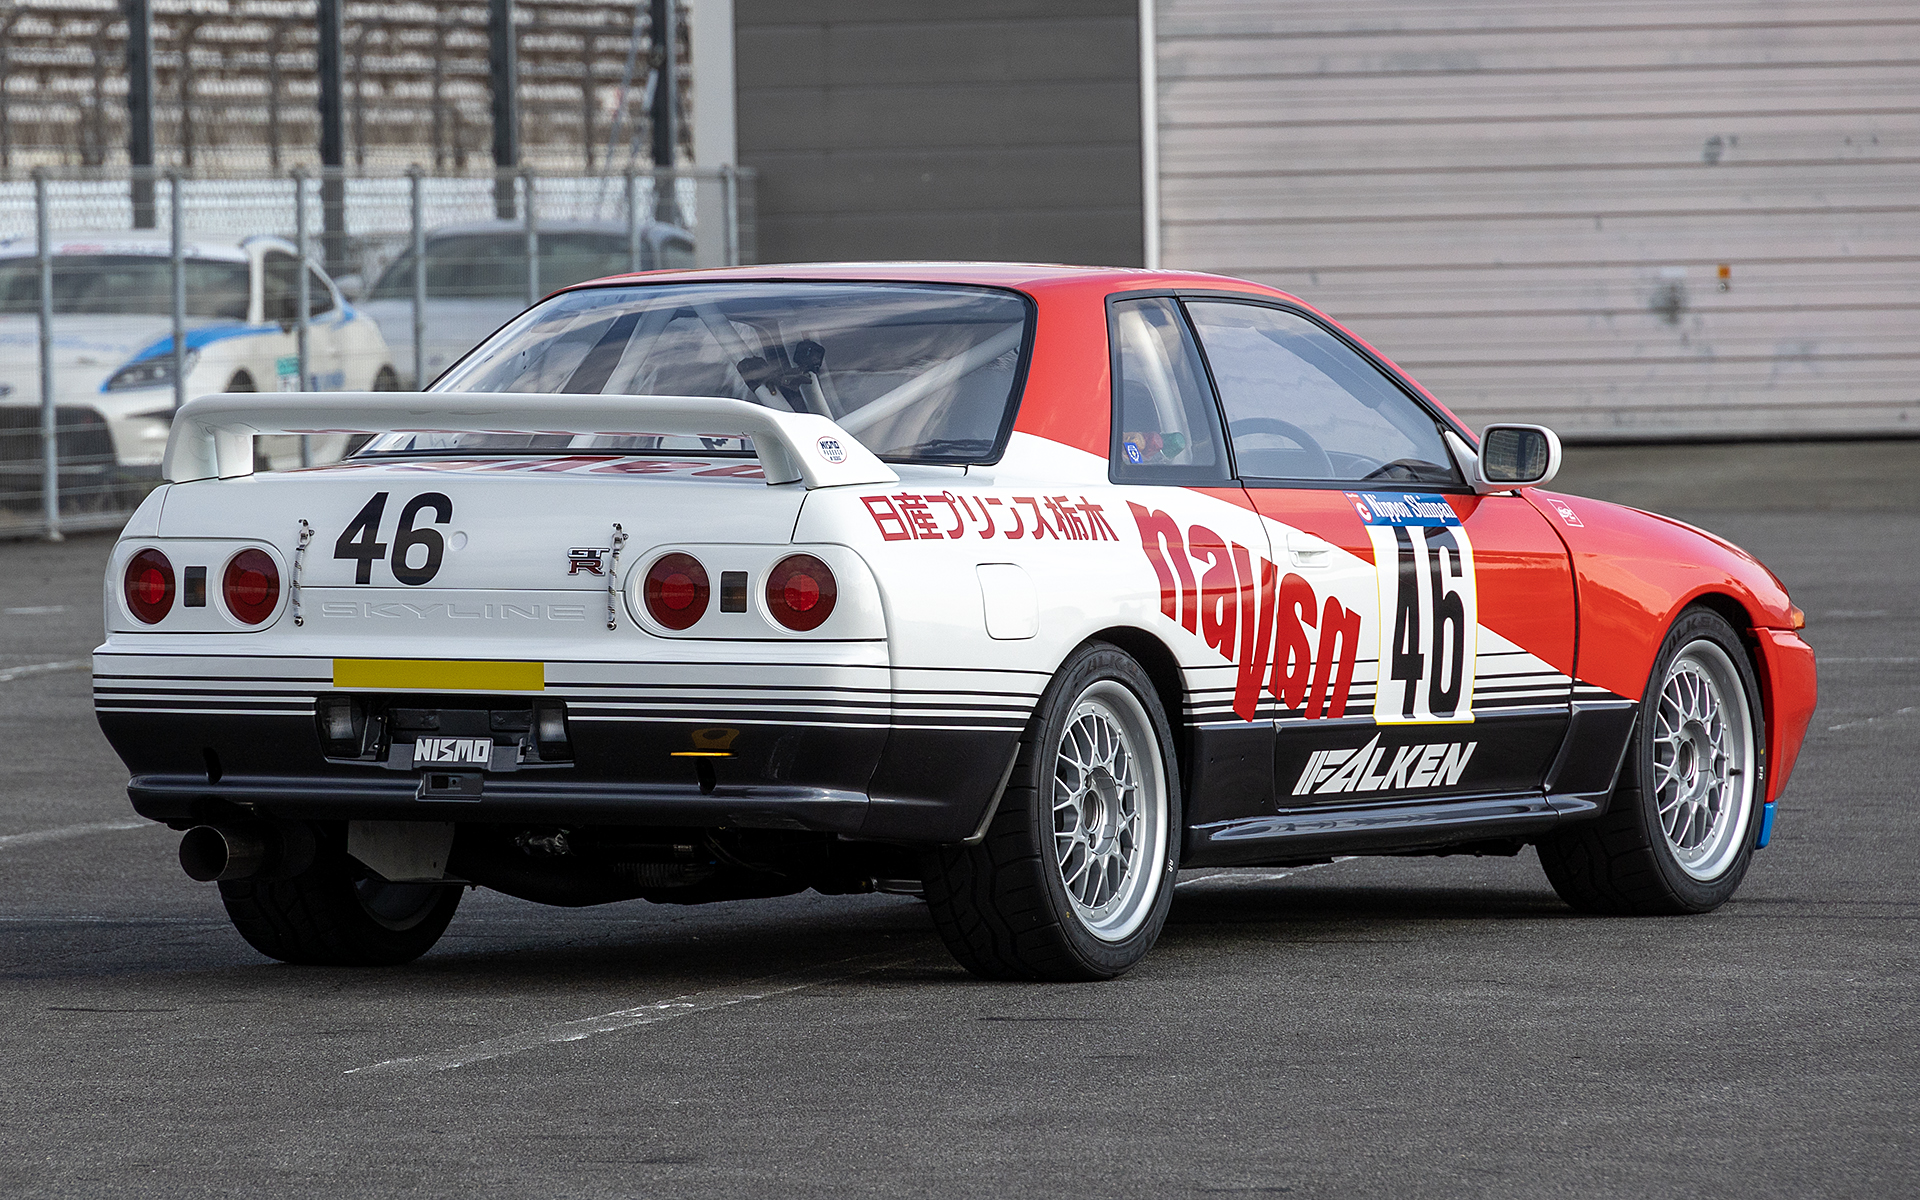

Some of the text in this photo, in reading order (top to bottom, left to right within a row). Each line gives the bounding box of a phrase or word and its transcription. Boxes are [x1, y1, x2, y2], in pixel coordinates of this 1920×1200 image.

[859, 490, 1119, 542] 日産プリンス栃木
[1362, 494, 1458, 523] Nippon Shinpan
[333, 491, 453, 586] 46
[567, 547, 610, 559] GT
[568, 559, 605, 576] R
[321, 601, 586, 621] SKYLINE
[1391, 526, 1465, 718] 46
[414, 738, 491, 763] NISMO
[1291, 731, 1479, 796] FALKEN
